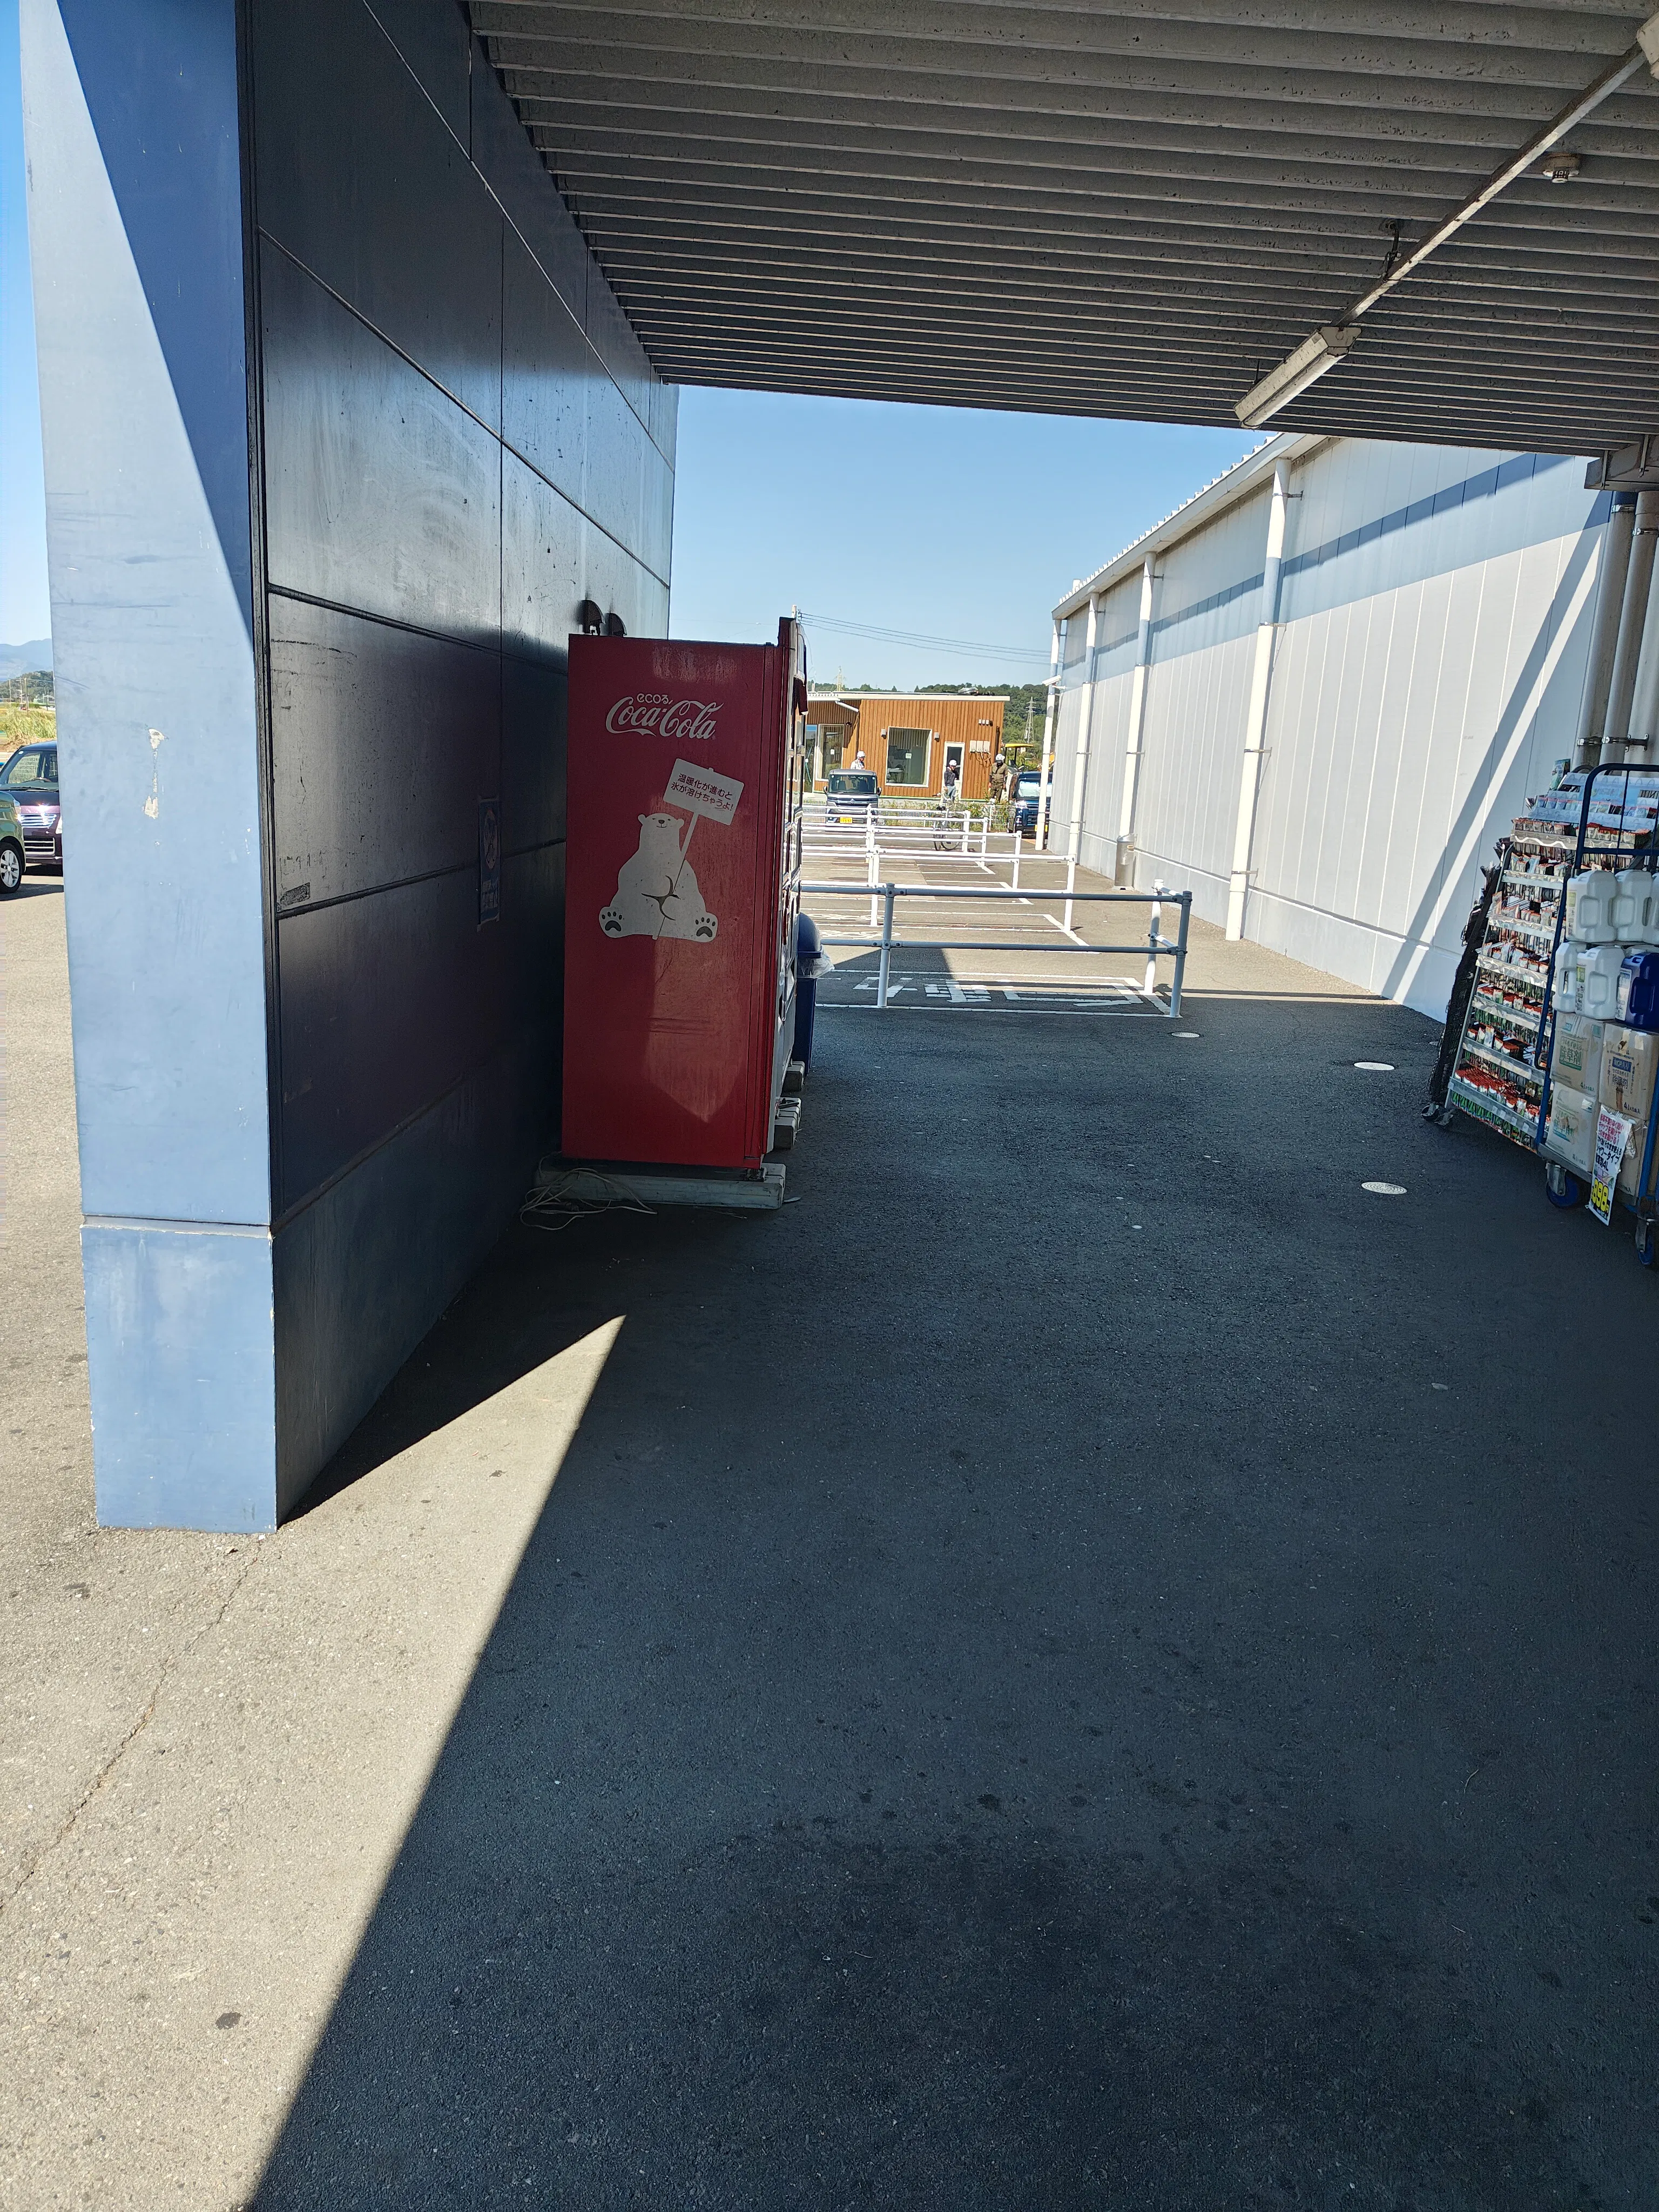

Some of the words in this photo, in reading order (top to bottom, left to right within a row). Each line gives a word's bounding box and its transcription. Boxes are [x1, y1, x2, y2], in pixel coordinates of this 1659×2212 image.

[606, 696, 724, 739] Coca-Cola
[671, 781, 734, 811] 氷が溶けちゃうよ!
[677, 773, 733, 800] 温暖化が進むと
